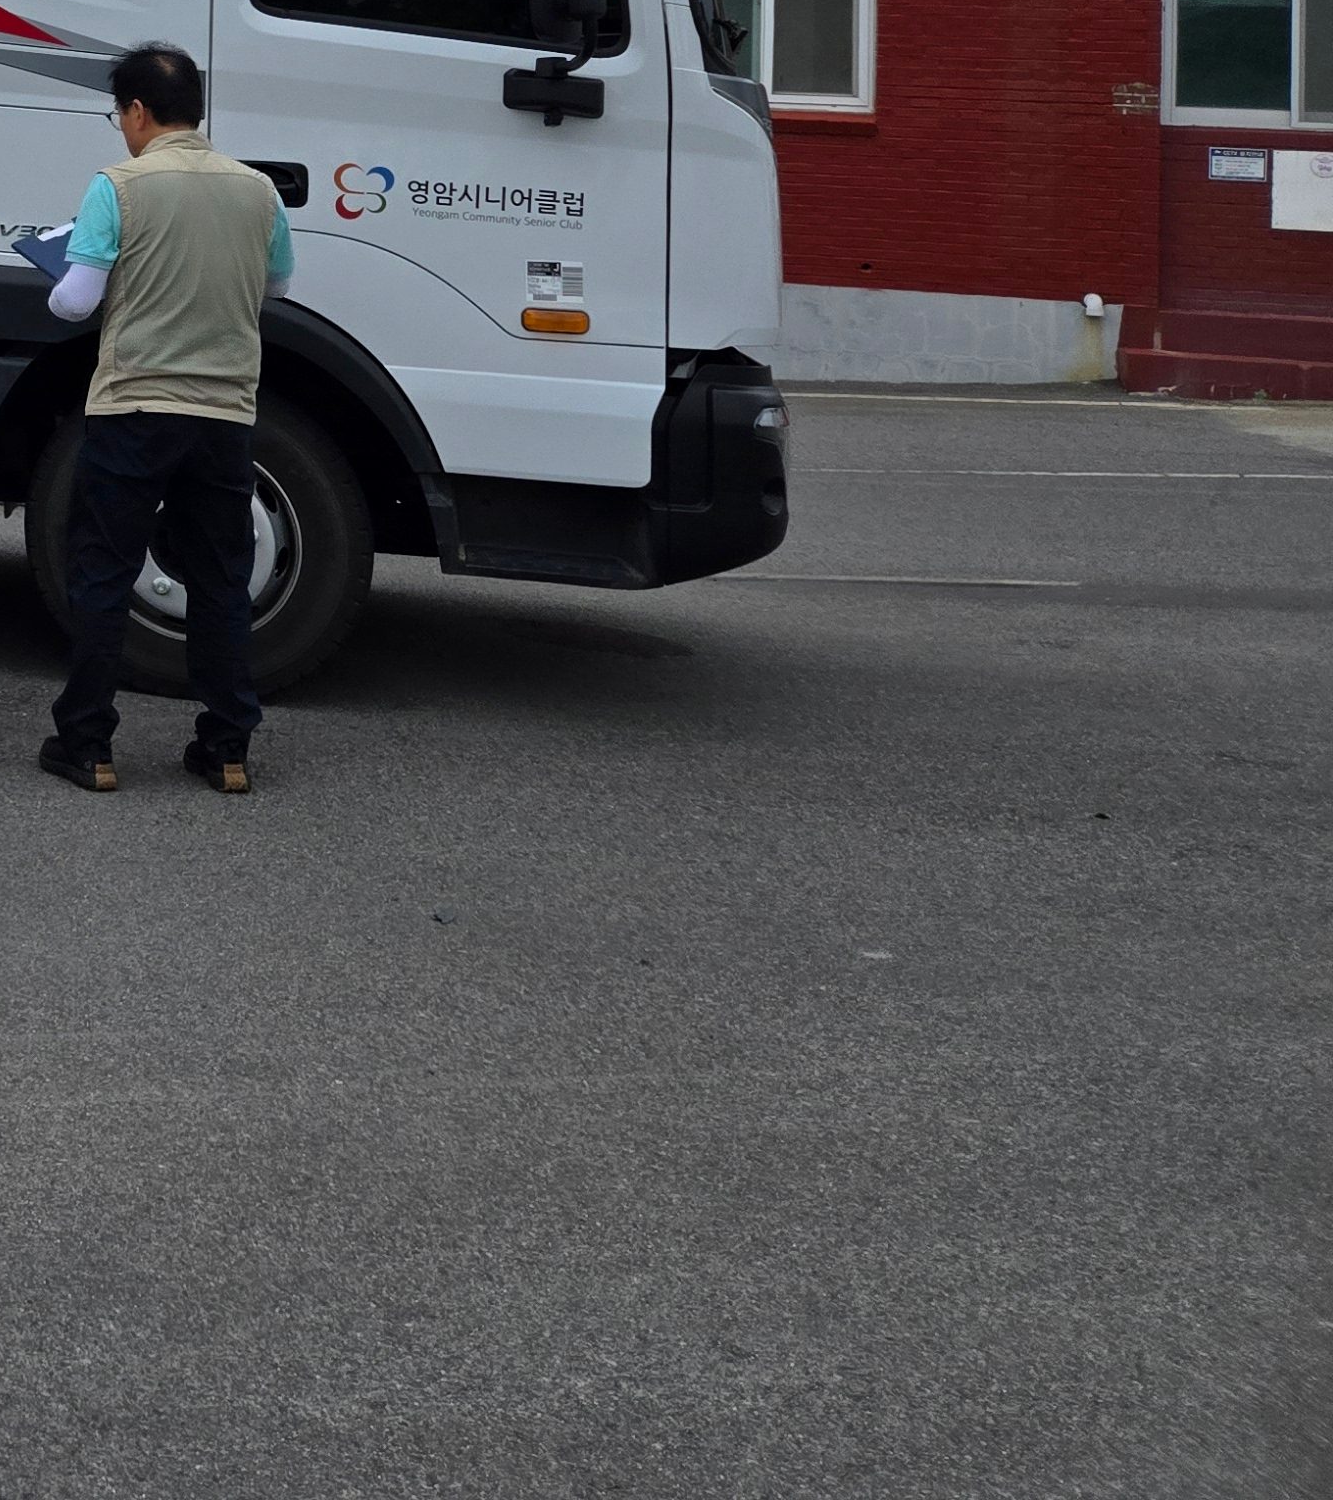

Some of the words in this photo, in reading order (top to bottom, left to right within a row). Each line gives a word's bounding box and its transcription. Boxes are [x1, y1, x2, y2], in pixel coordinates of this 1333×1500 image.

[407, 180, 585, 218] 영암시니어클럽
[412, 207, 460, 220] Yeongam
[462, 211, 521, 226] Community
[524, 217, 557, 228] Senior
[559, 219, 583, 230] Club
